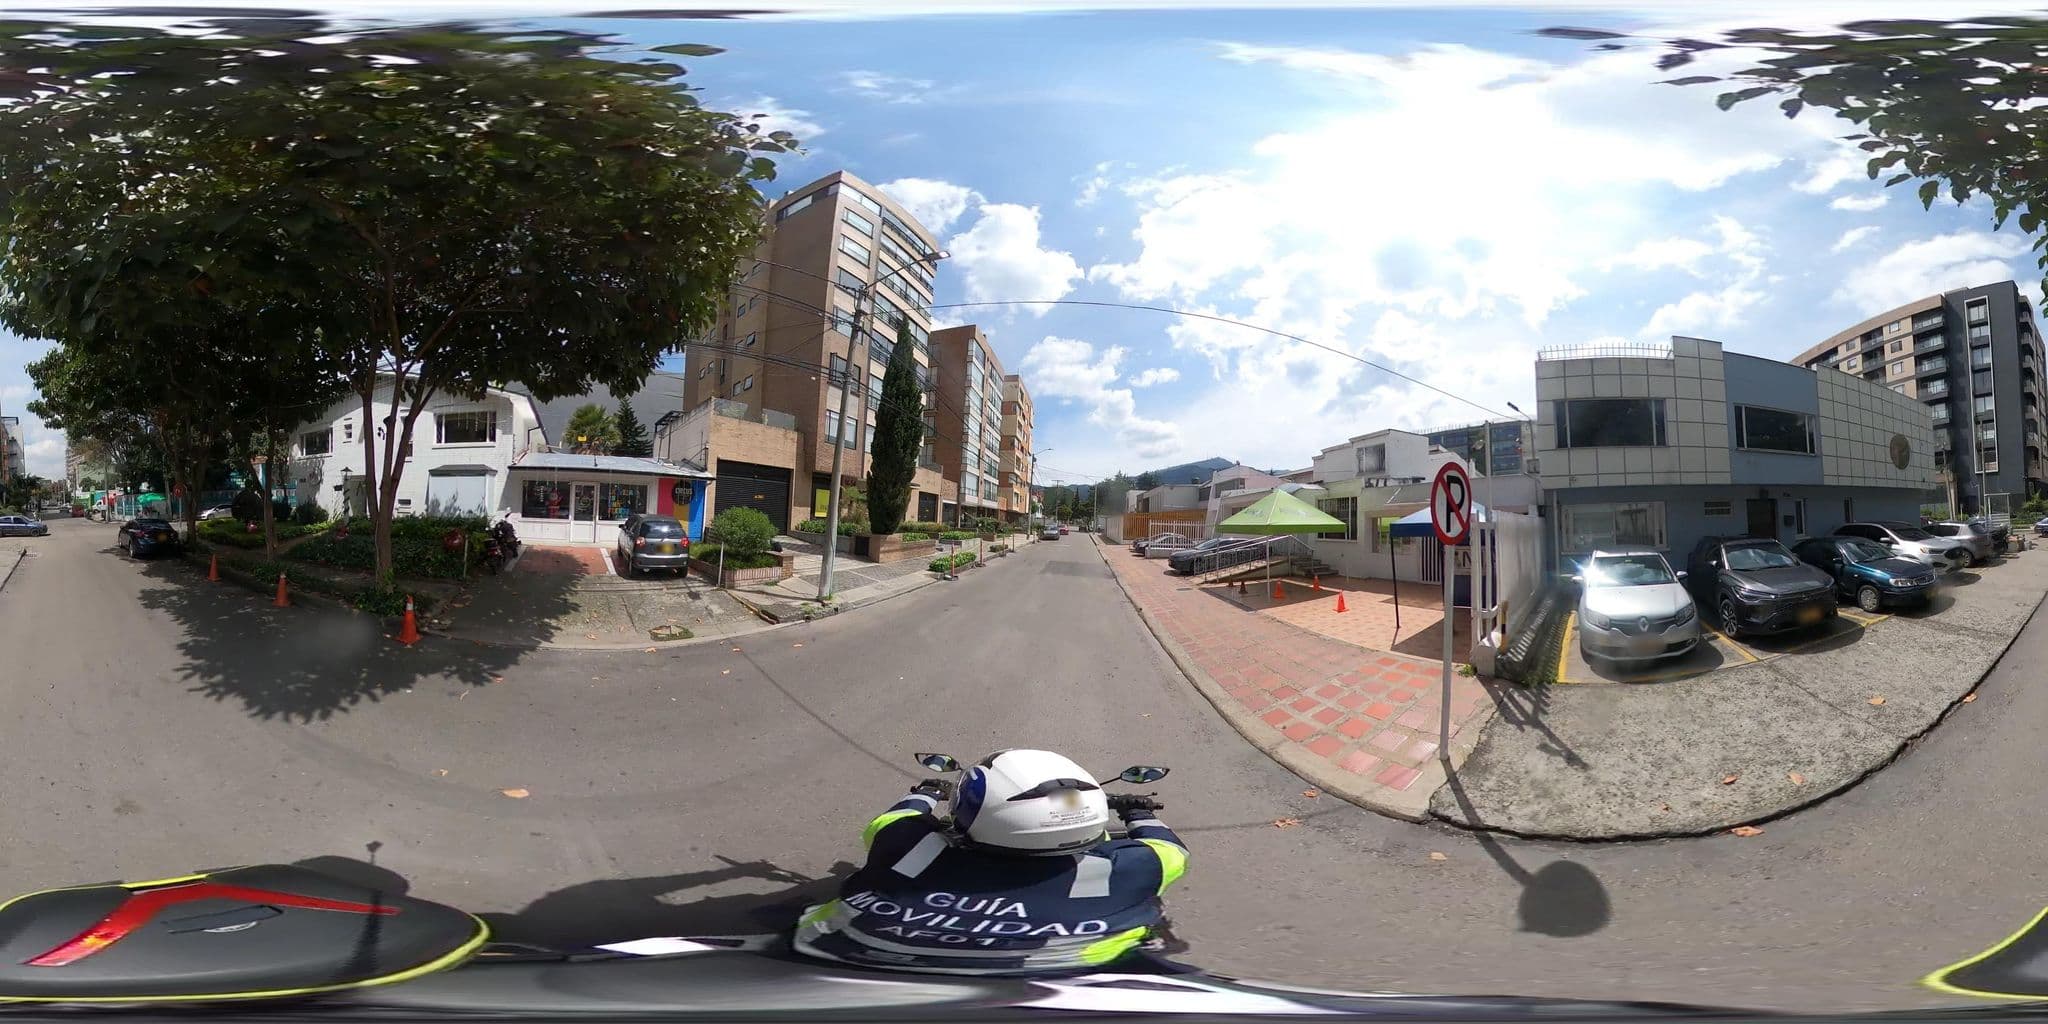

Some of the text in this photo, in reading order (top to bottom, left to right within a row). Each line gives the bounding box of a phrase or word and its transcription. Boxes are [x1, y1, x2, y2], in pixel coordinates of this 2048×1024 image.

[1446, 475, 1465, 533] P
[845, 891, 1108, 936] MOVILIDAD
[925, 892, 1028, 918] GUÍA
